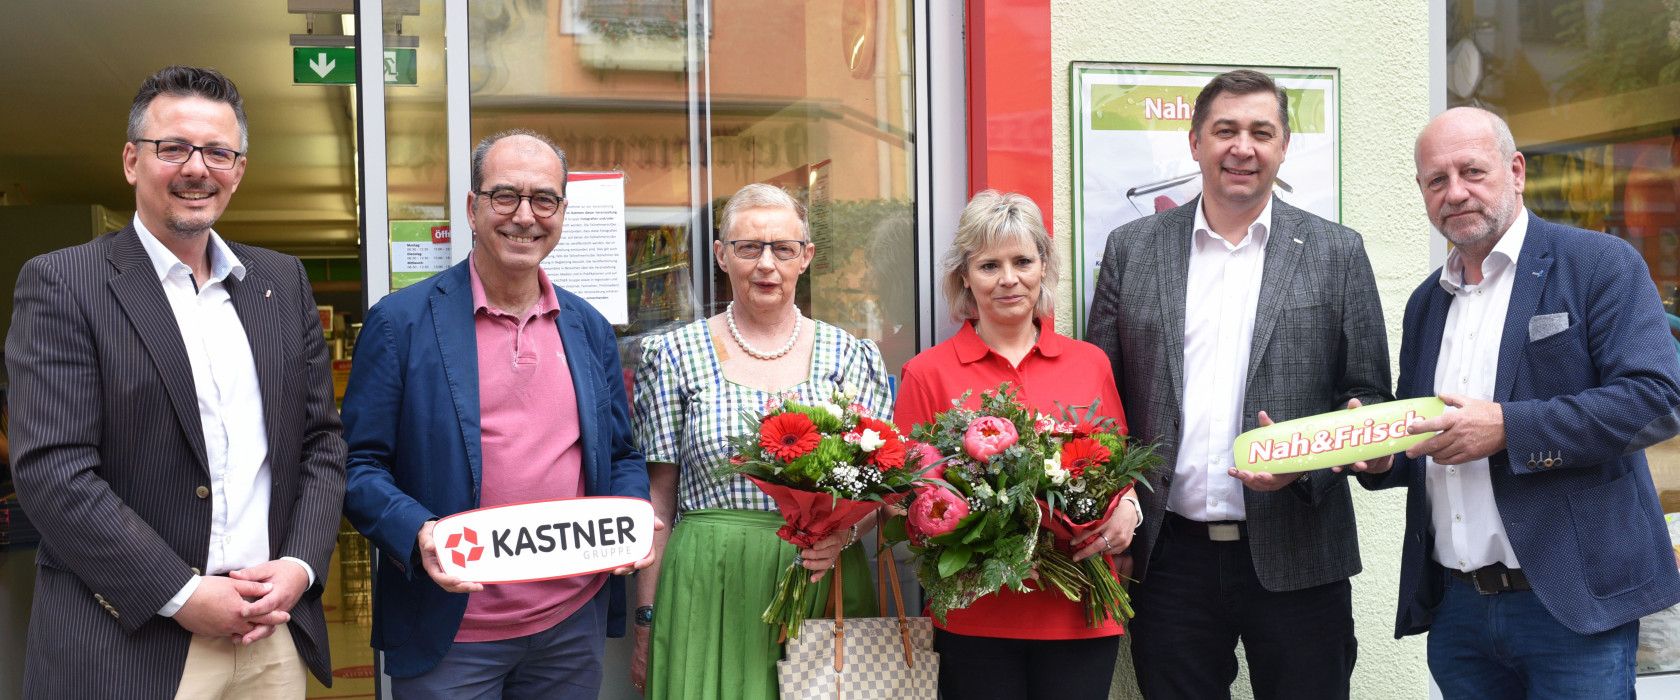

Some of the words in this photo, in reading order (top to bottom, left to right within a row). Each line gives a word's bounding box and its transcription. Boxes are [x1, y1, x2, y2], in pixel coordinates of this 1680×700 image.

[1144, 96, 1198, 120] Nah
[492, 516, 636, 558] KASTNER
[583, 546, 632, 560] GRUPPE
